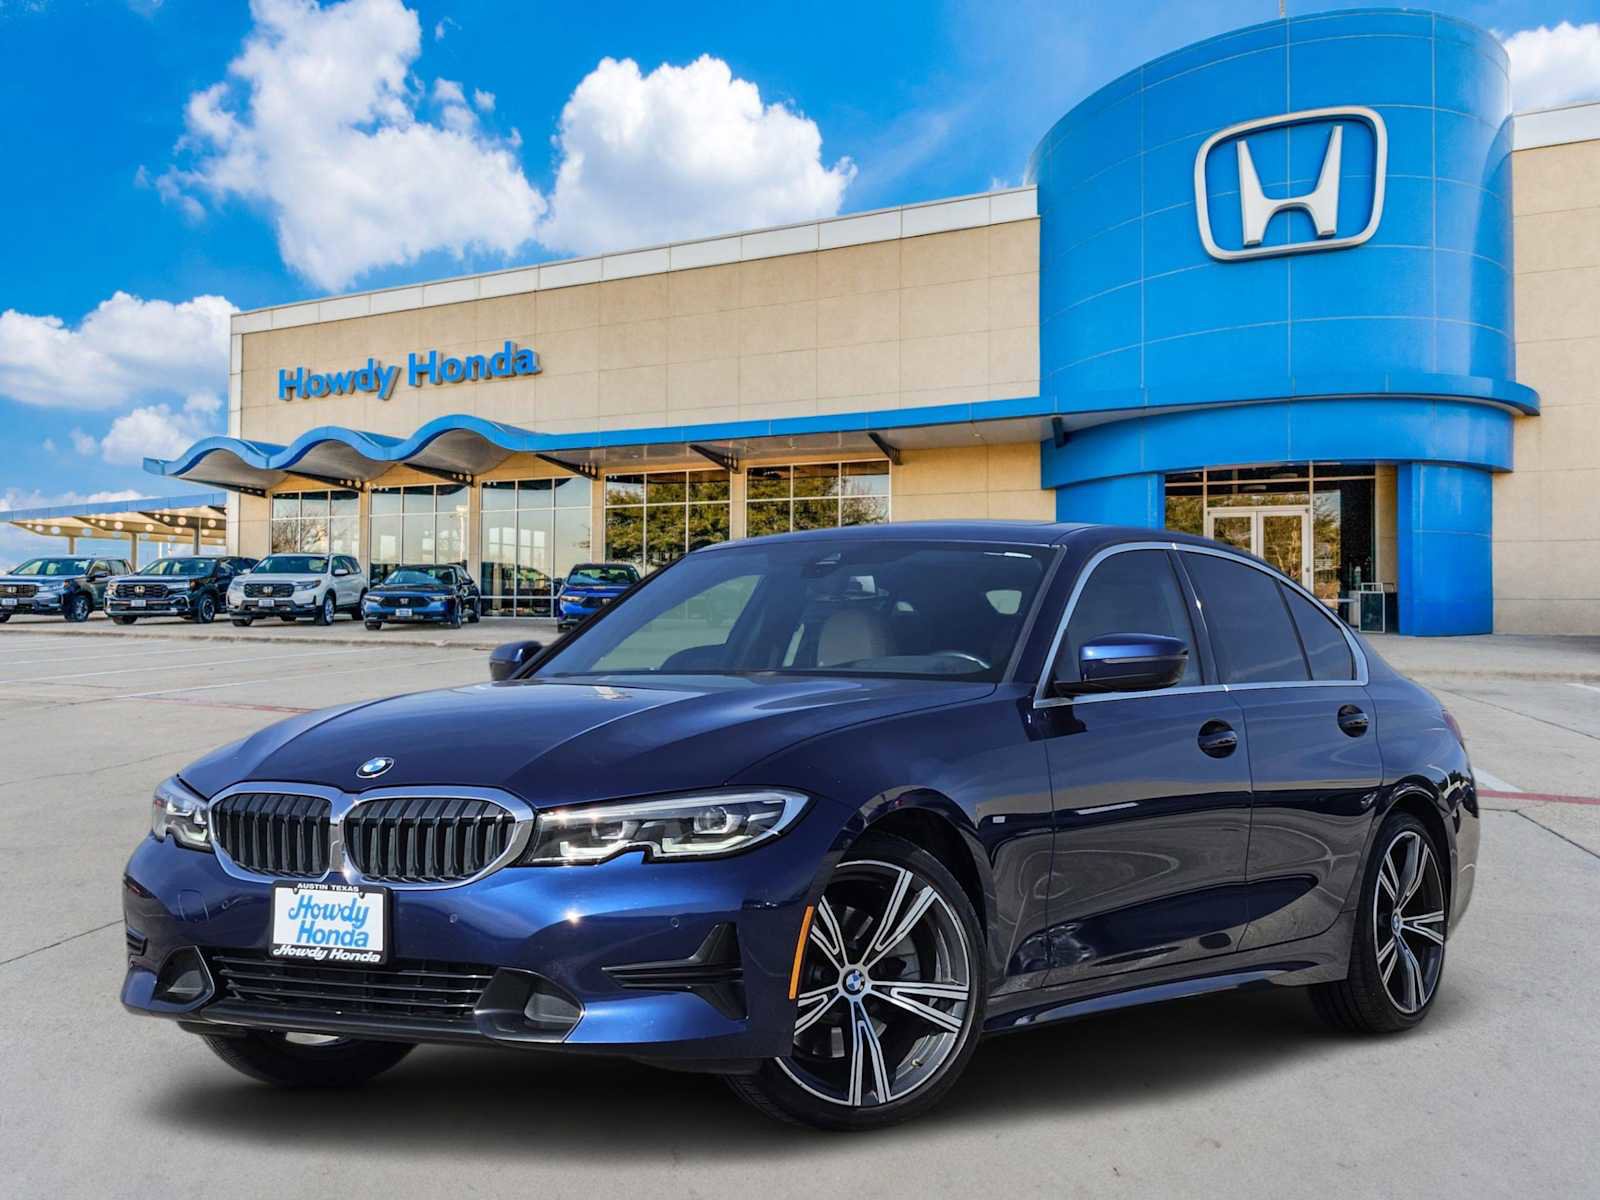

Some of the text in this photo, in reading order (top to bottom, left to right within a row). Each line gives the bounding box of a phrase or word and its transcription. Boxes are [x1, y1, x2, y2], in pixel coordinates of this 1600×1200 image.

[279, 340, 541, 401] Howdy Honda
[331, 884, 359, 892] TEXAS
[288, 895, 369, 929] Howdy
[296, 920, 369, 947] Honda
[272, 945, 381, 962] Howdy Honda
